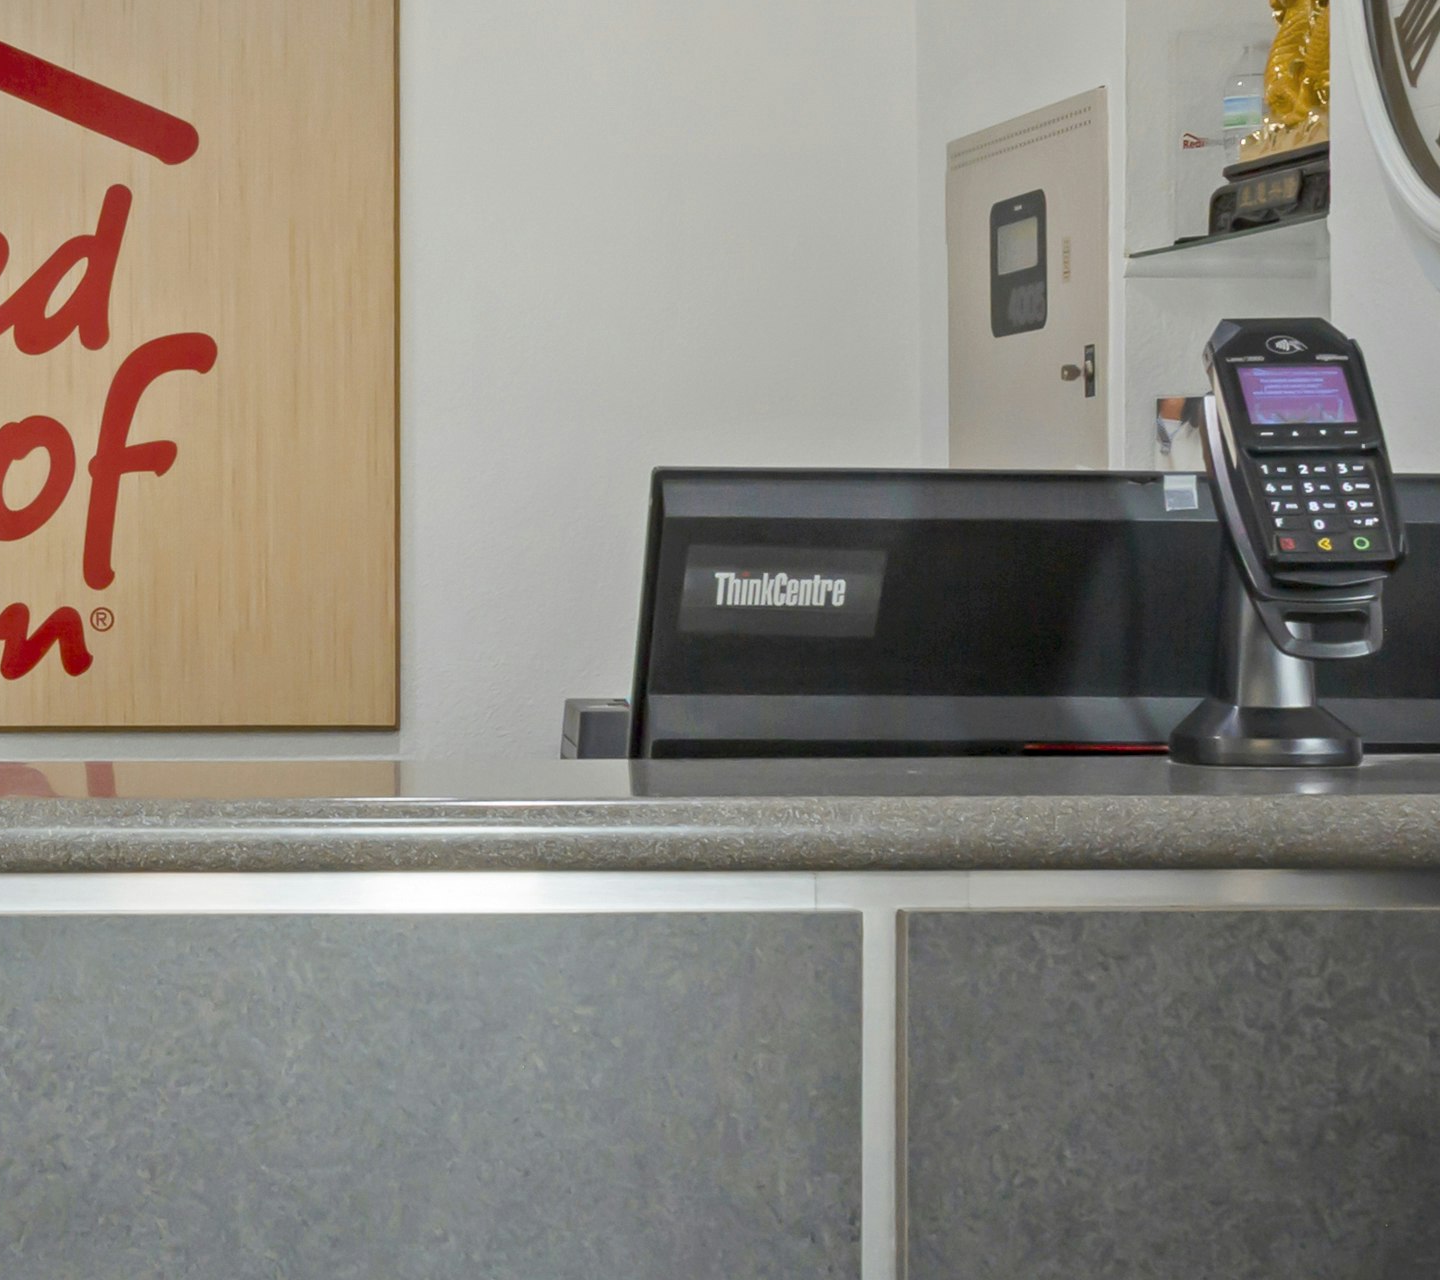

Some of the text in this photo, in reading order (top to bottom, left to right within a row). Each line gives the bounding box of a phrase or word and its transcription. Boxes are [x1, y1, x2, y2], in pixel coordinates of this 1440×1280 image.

[1298, 464, 1309, 474] 2
[1337, 463, 1348, 474] 3
[1265, 483, 1276, 493] 4
[1303, 482, 1314, 493] 5
[1342, 482, 1353, 492] 6
[1270, 501, 1280, 512] 7
[1308, 501, 1319, 512] 8
[1346, 500, 1358, 511] 9
[714, 570, 847, 607] ThinkCentre
